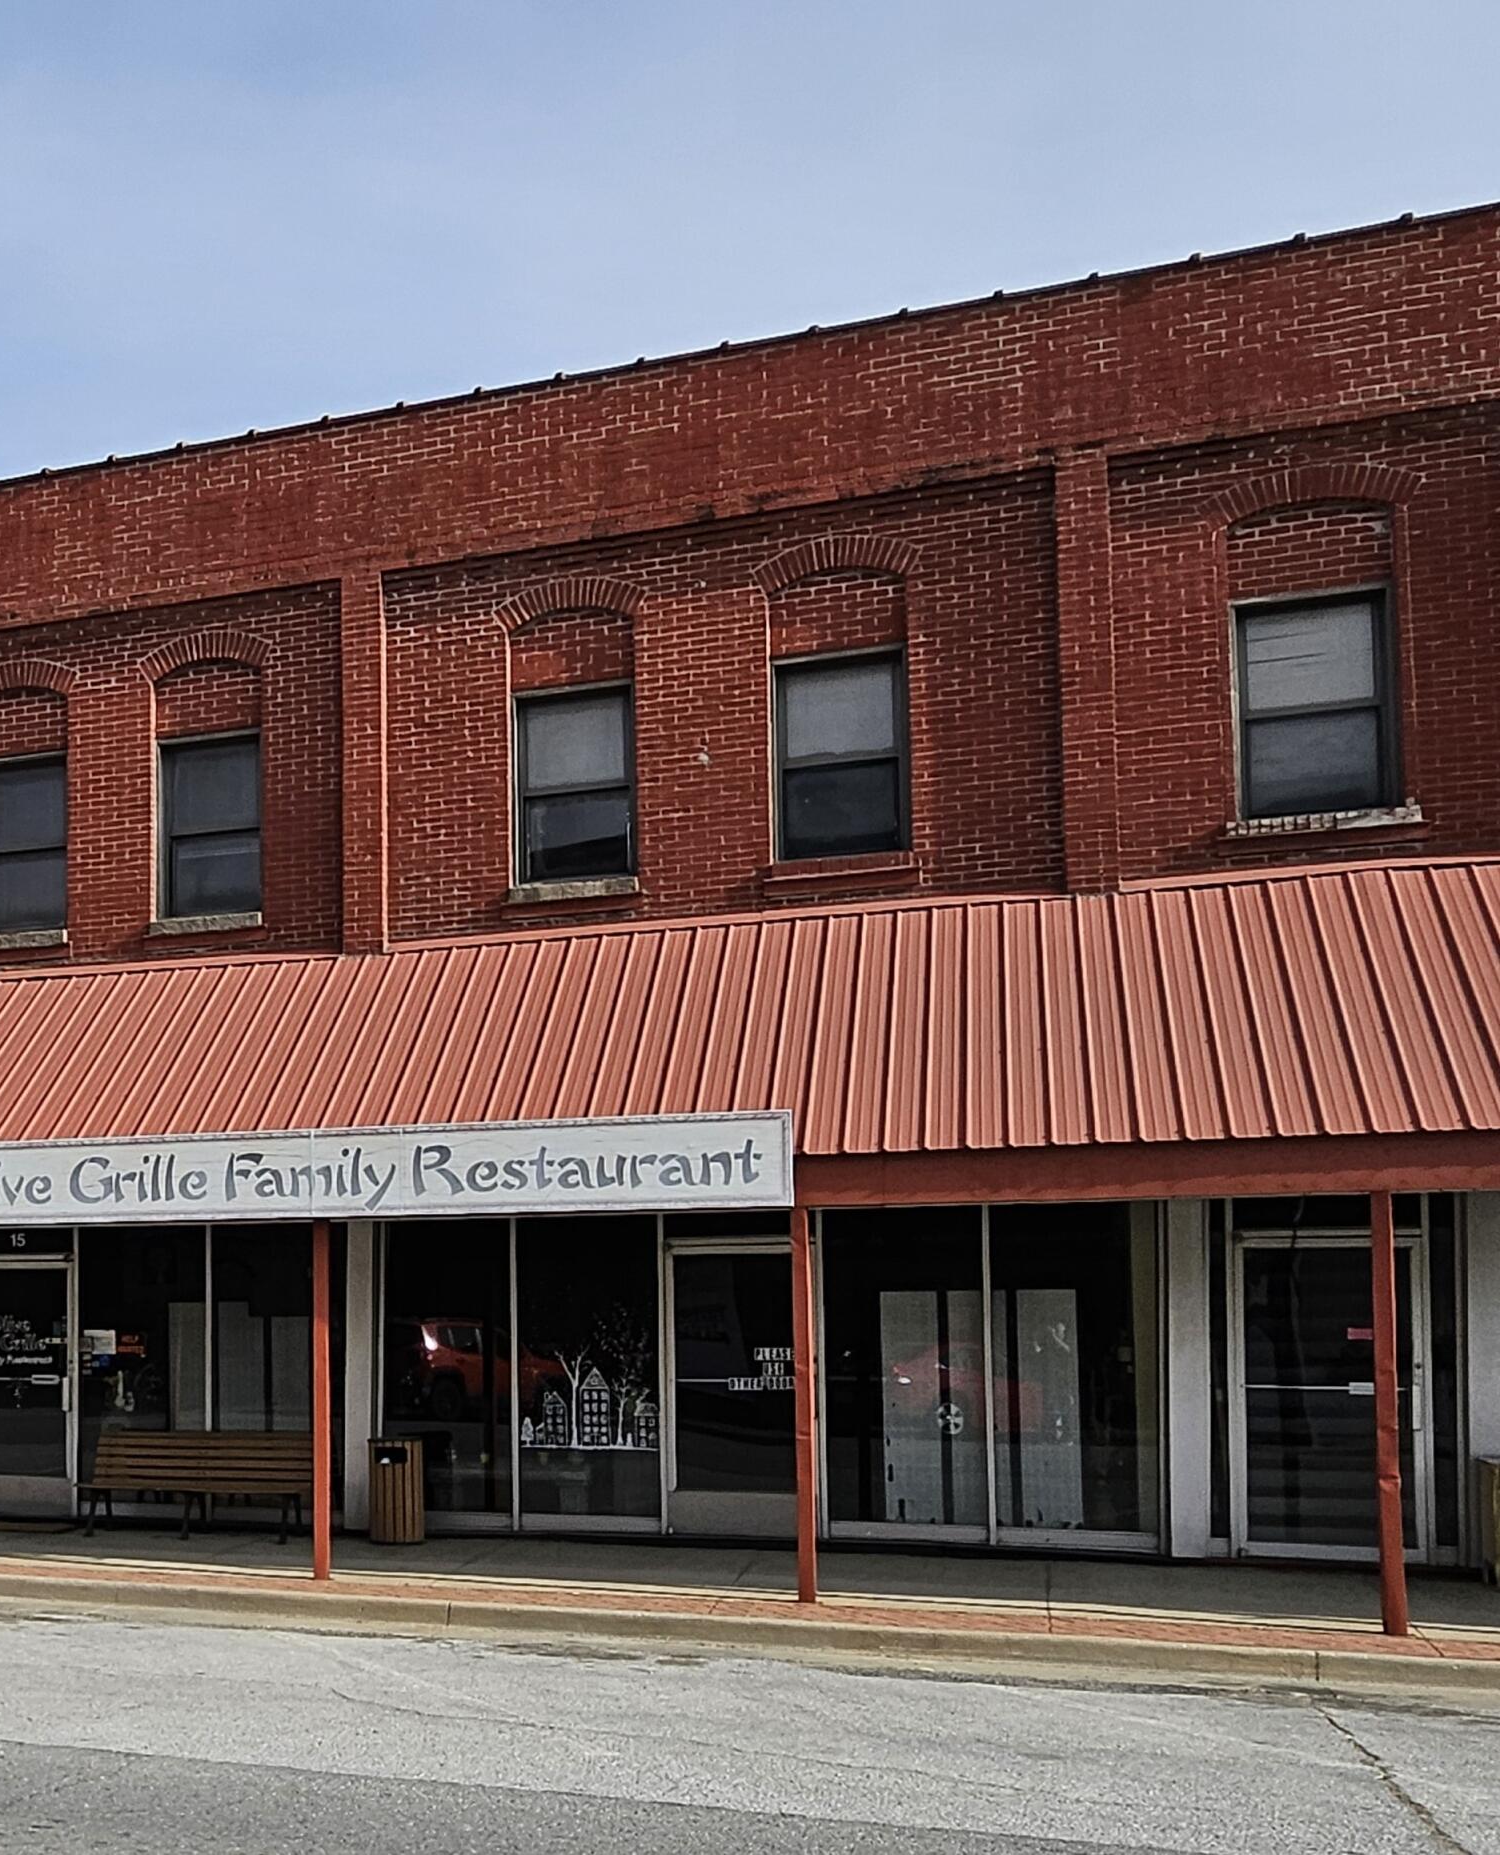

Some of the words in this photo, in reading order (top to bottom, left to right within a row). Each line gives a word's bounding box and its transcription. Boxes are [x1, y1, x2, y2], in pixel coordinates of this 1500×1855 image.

[69, 1153, 208, 1204] Grille
[224, 1145, 396, 1211] Family
[412, 1138, 763, 1198] Restaurant
[10, 1233, 26, 1247] 15
